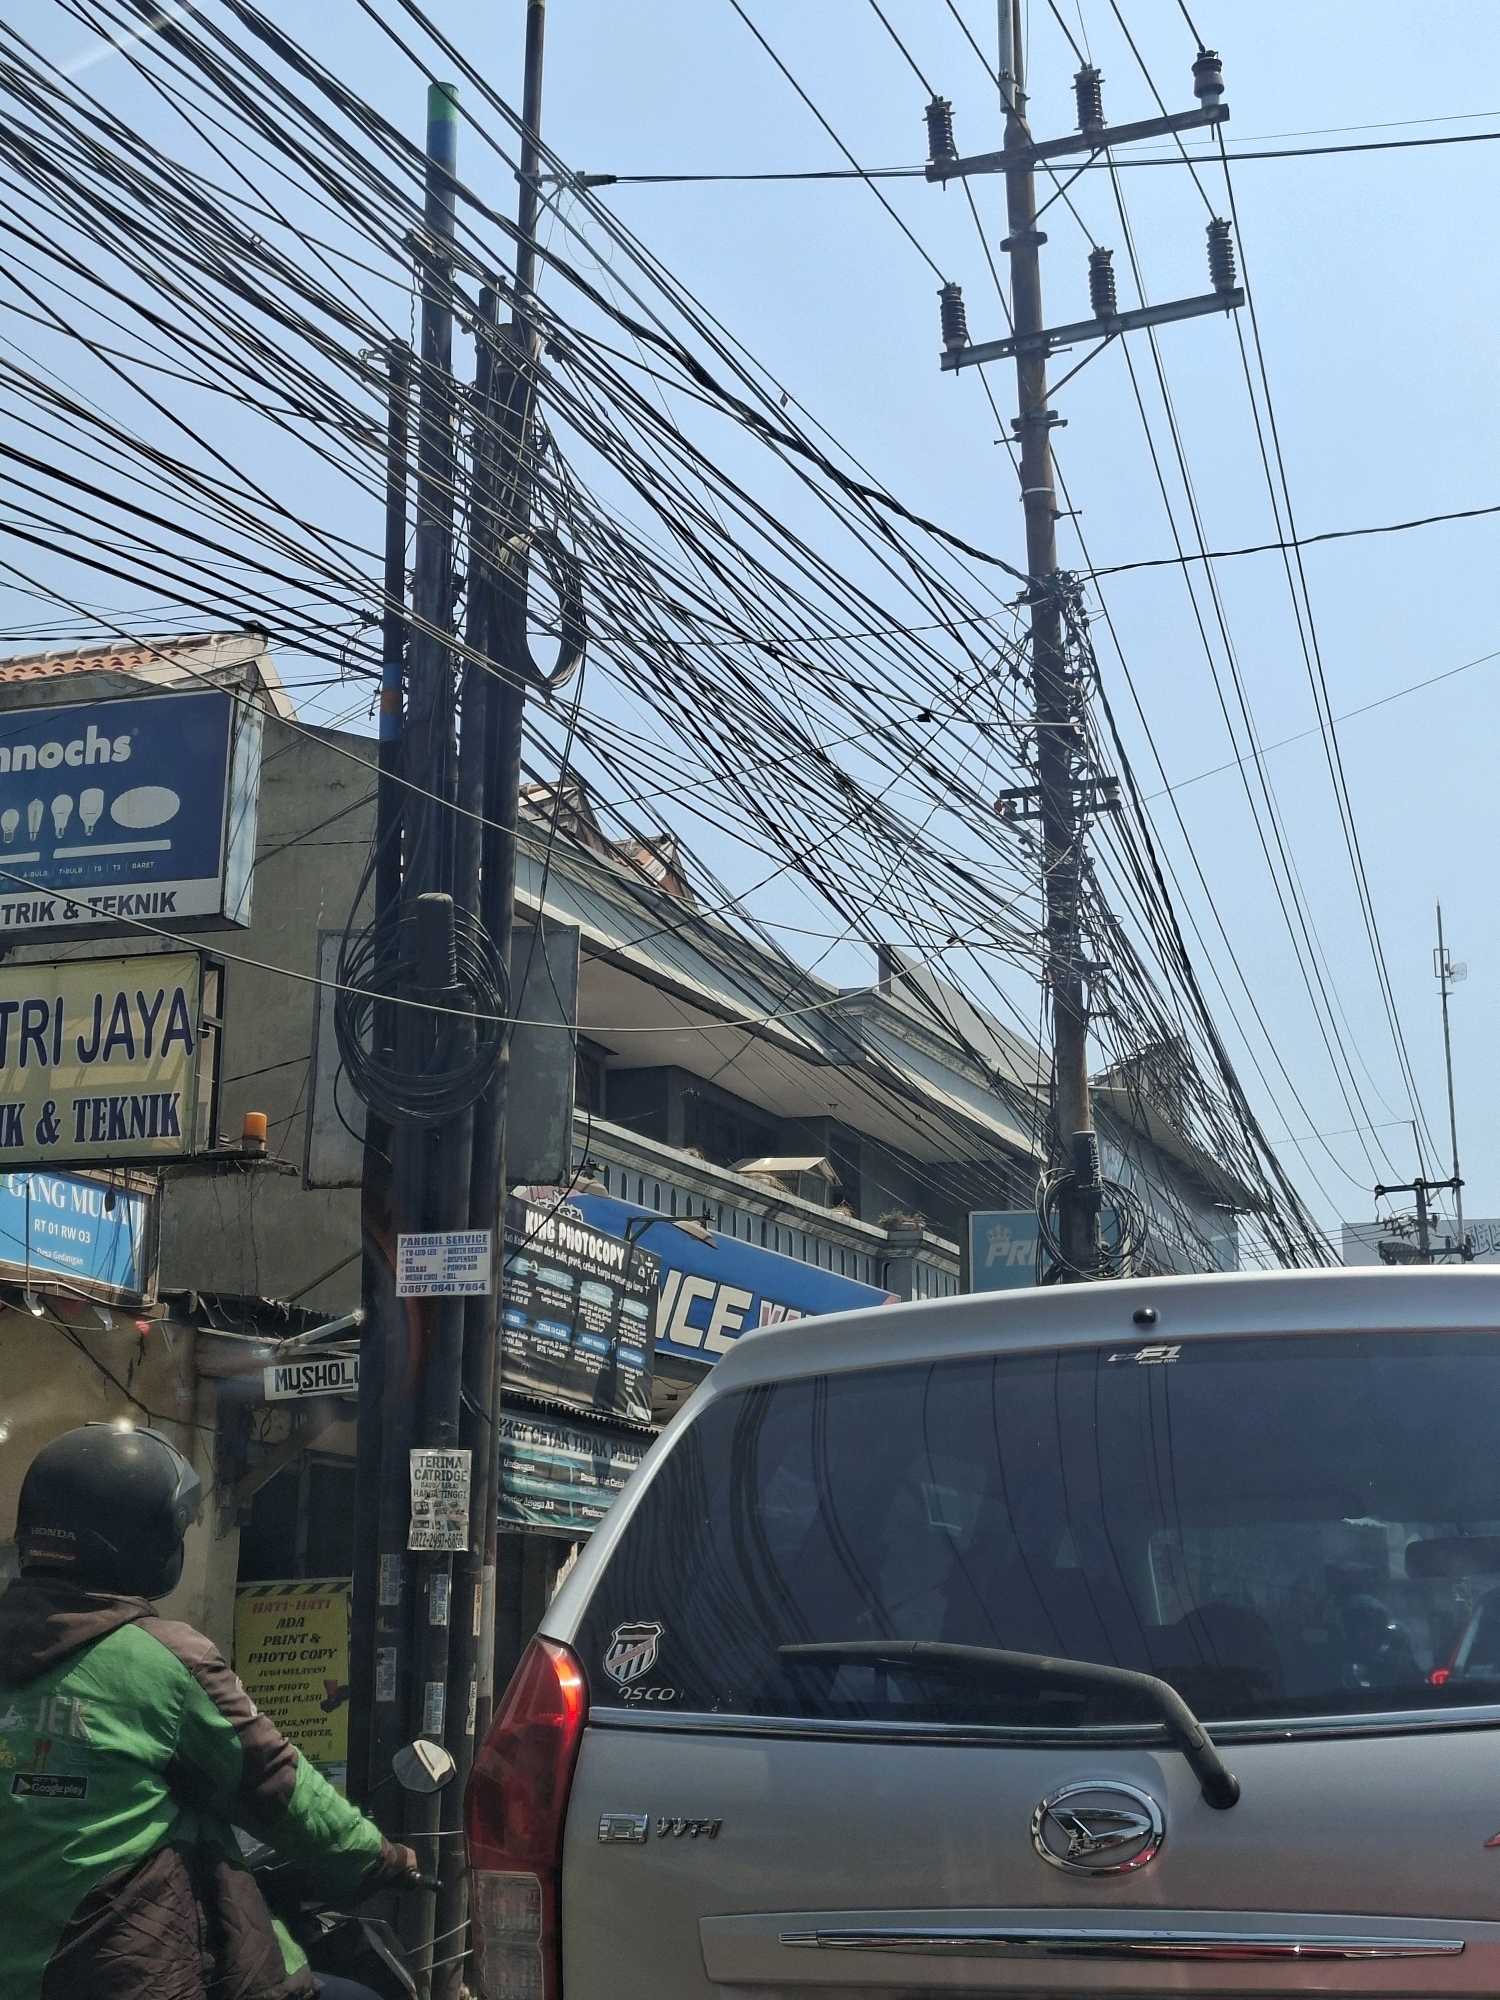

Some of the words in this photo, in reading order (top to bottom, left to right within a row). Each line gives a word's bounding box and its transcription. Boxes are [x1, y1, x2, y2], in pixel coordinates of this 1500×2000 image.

[1, 900, 56, 926] TRIK
[63, 899, 79, 920] &
[88, 891, 178, 920] TEKNIK
[77, 986, 194, 1064] JAYA
[35, 1100, 61, 1145] &
[72, 1092, 181, 1143] TEKNIK
[8, 1172, 66, 1208] GANG
[34, 1218, 47, 1232] RT
[61, 1224, 77, 1240] RW
[400, 1236, 443, 1247] PANGGIL
[445, 1234, 488, 1245] SERVICE
[525, 1209, 556, 1243] KING
[558, 1222, 626, 1271] PHOTOCOPY
[418, 1456, 462, 1469] TERIMA
[413, 1469, 468, 1482] CATRIDGE
[30, 1526, 77, 1541] HONDA
[276, 1617, 305, 1629] ADA
[263, 1633, 309, 1646] PRINT
[310, 1632, 321, 1644] &
[248, 1651, 298, 1663] PHOTO
[300, 1648, 338, 1661] COPY
[32, 1783, 64, 1796] Google
[63, 1785, 84, 1795] play
